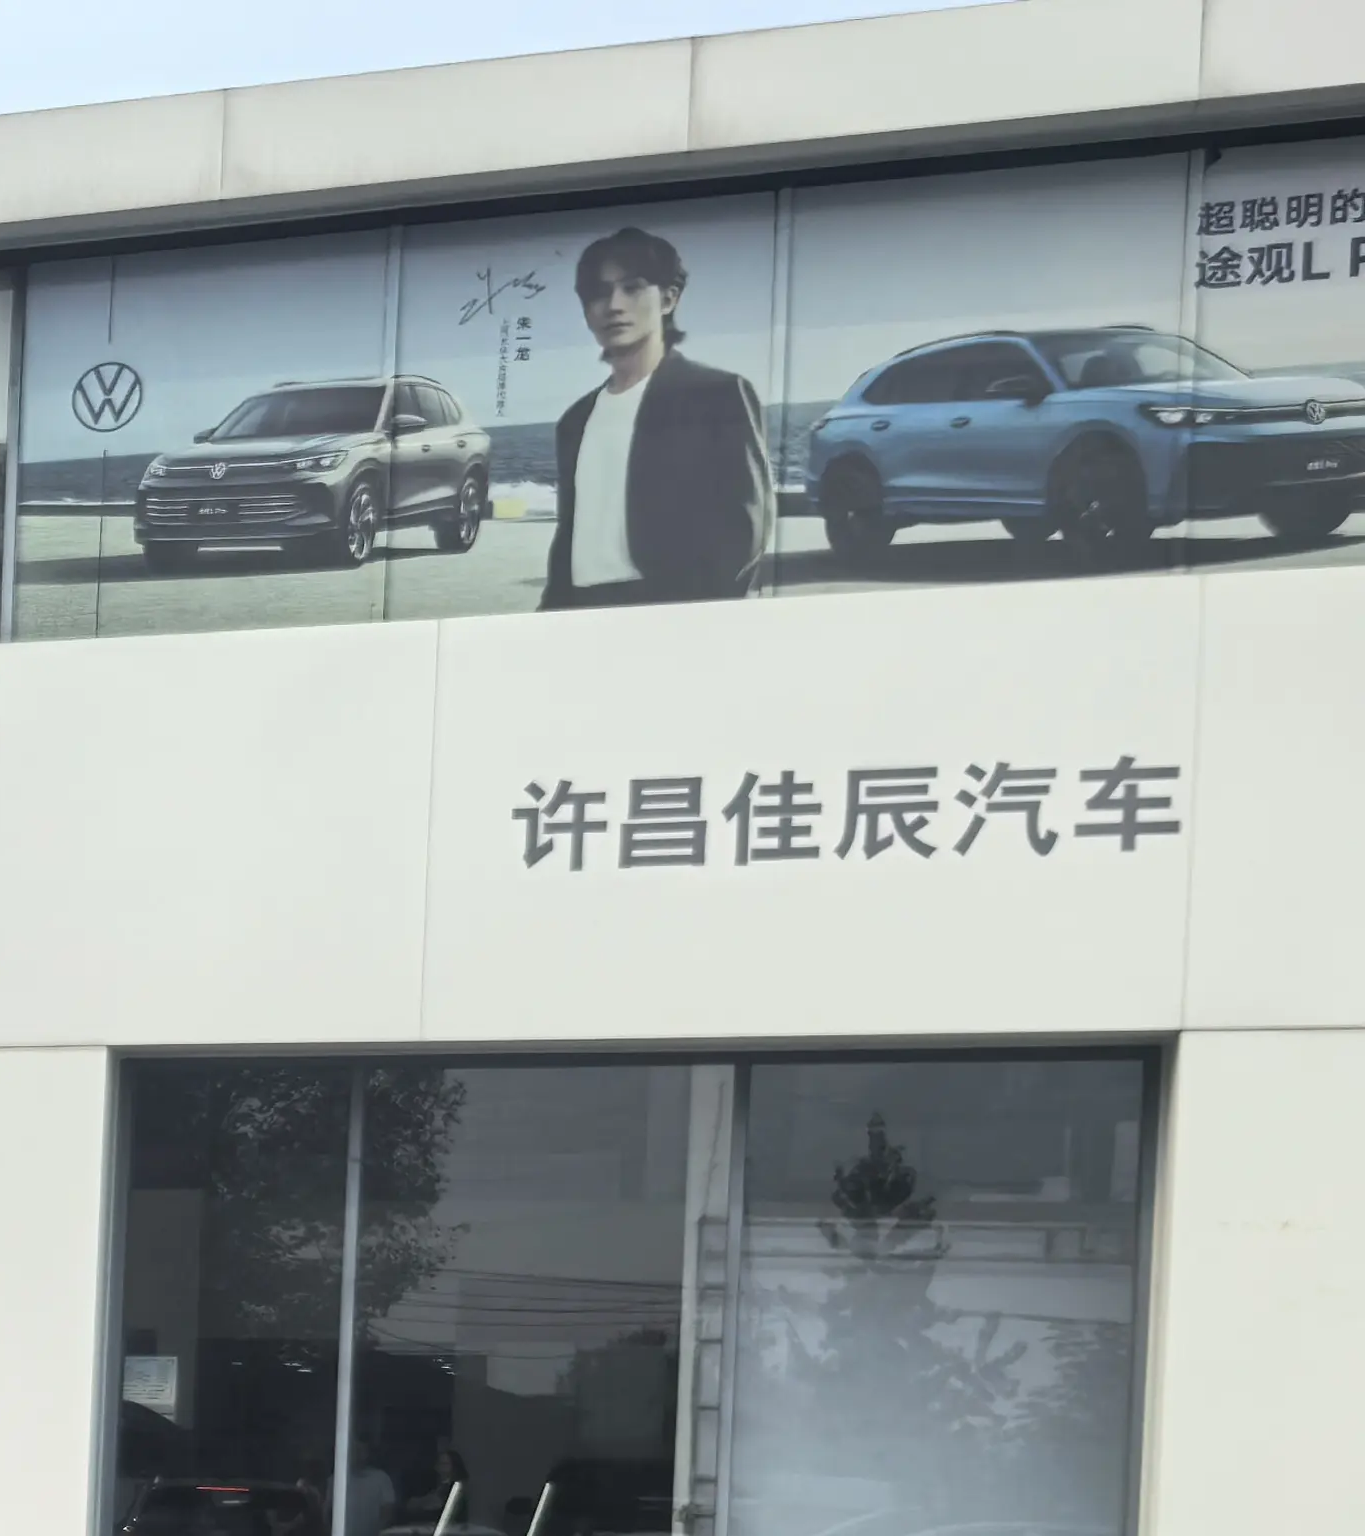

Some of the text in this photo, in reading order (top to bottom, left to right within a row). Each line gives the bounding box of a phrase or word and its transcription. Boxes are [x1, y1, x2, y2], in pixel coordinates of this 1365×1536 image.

[1195, 188, 1365, 236] 超聪明的
[1194, 240, 1331, 290] 途观L
[511, 755, 1182, 873] 许昌佳辰汽车
